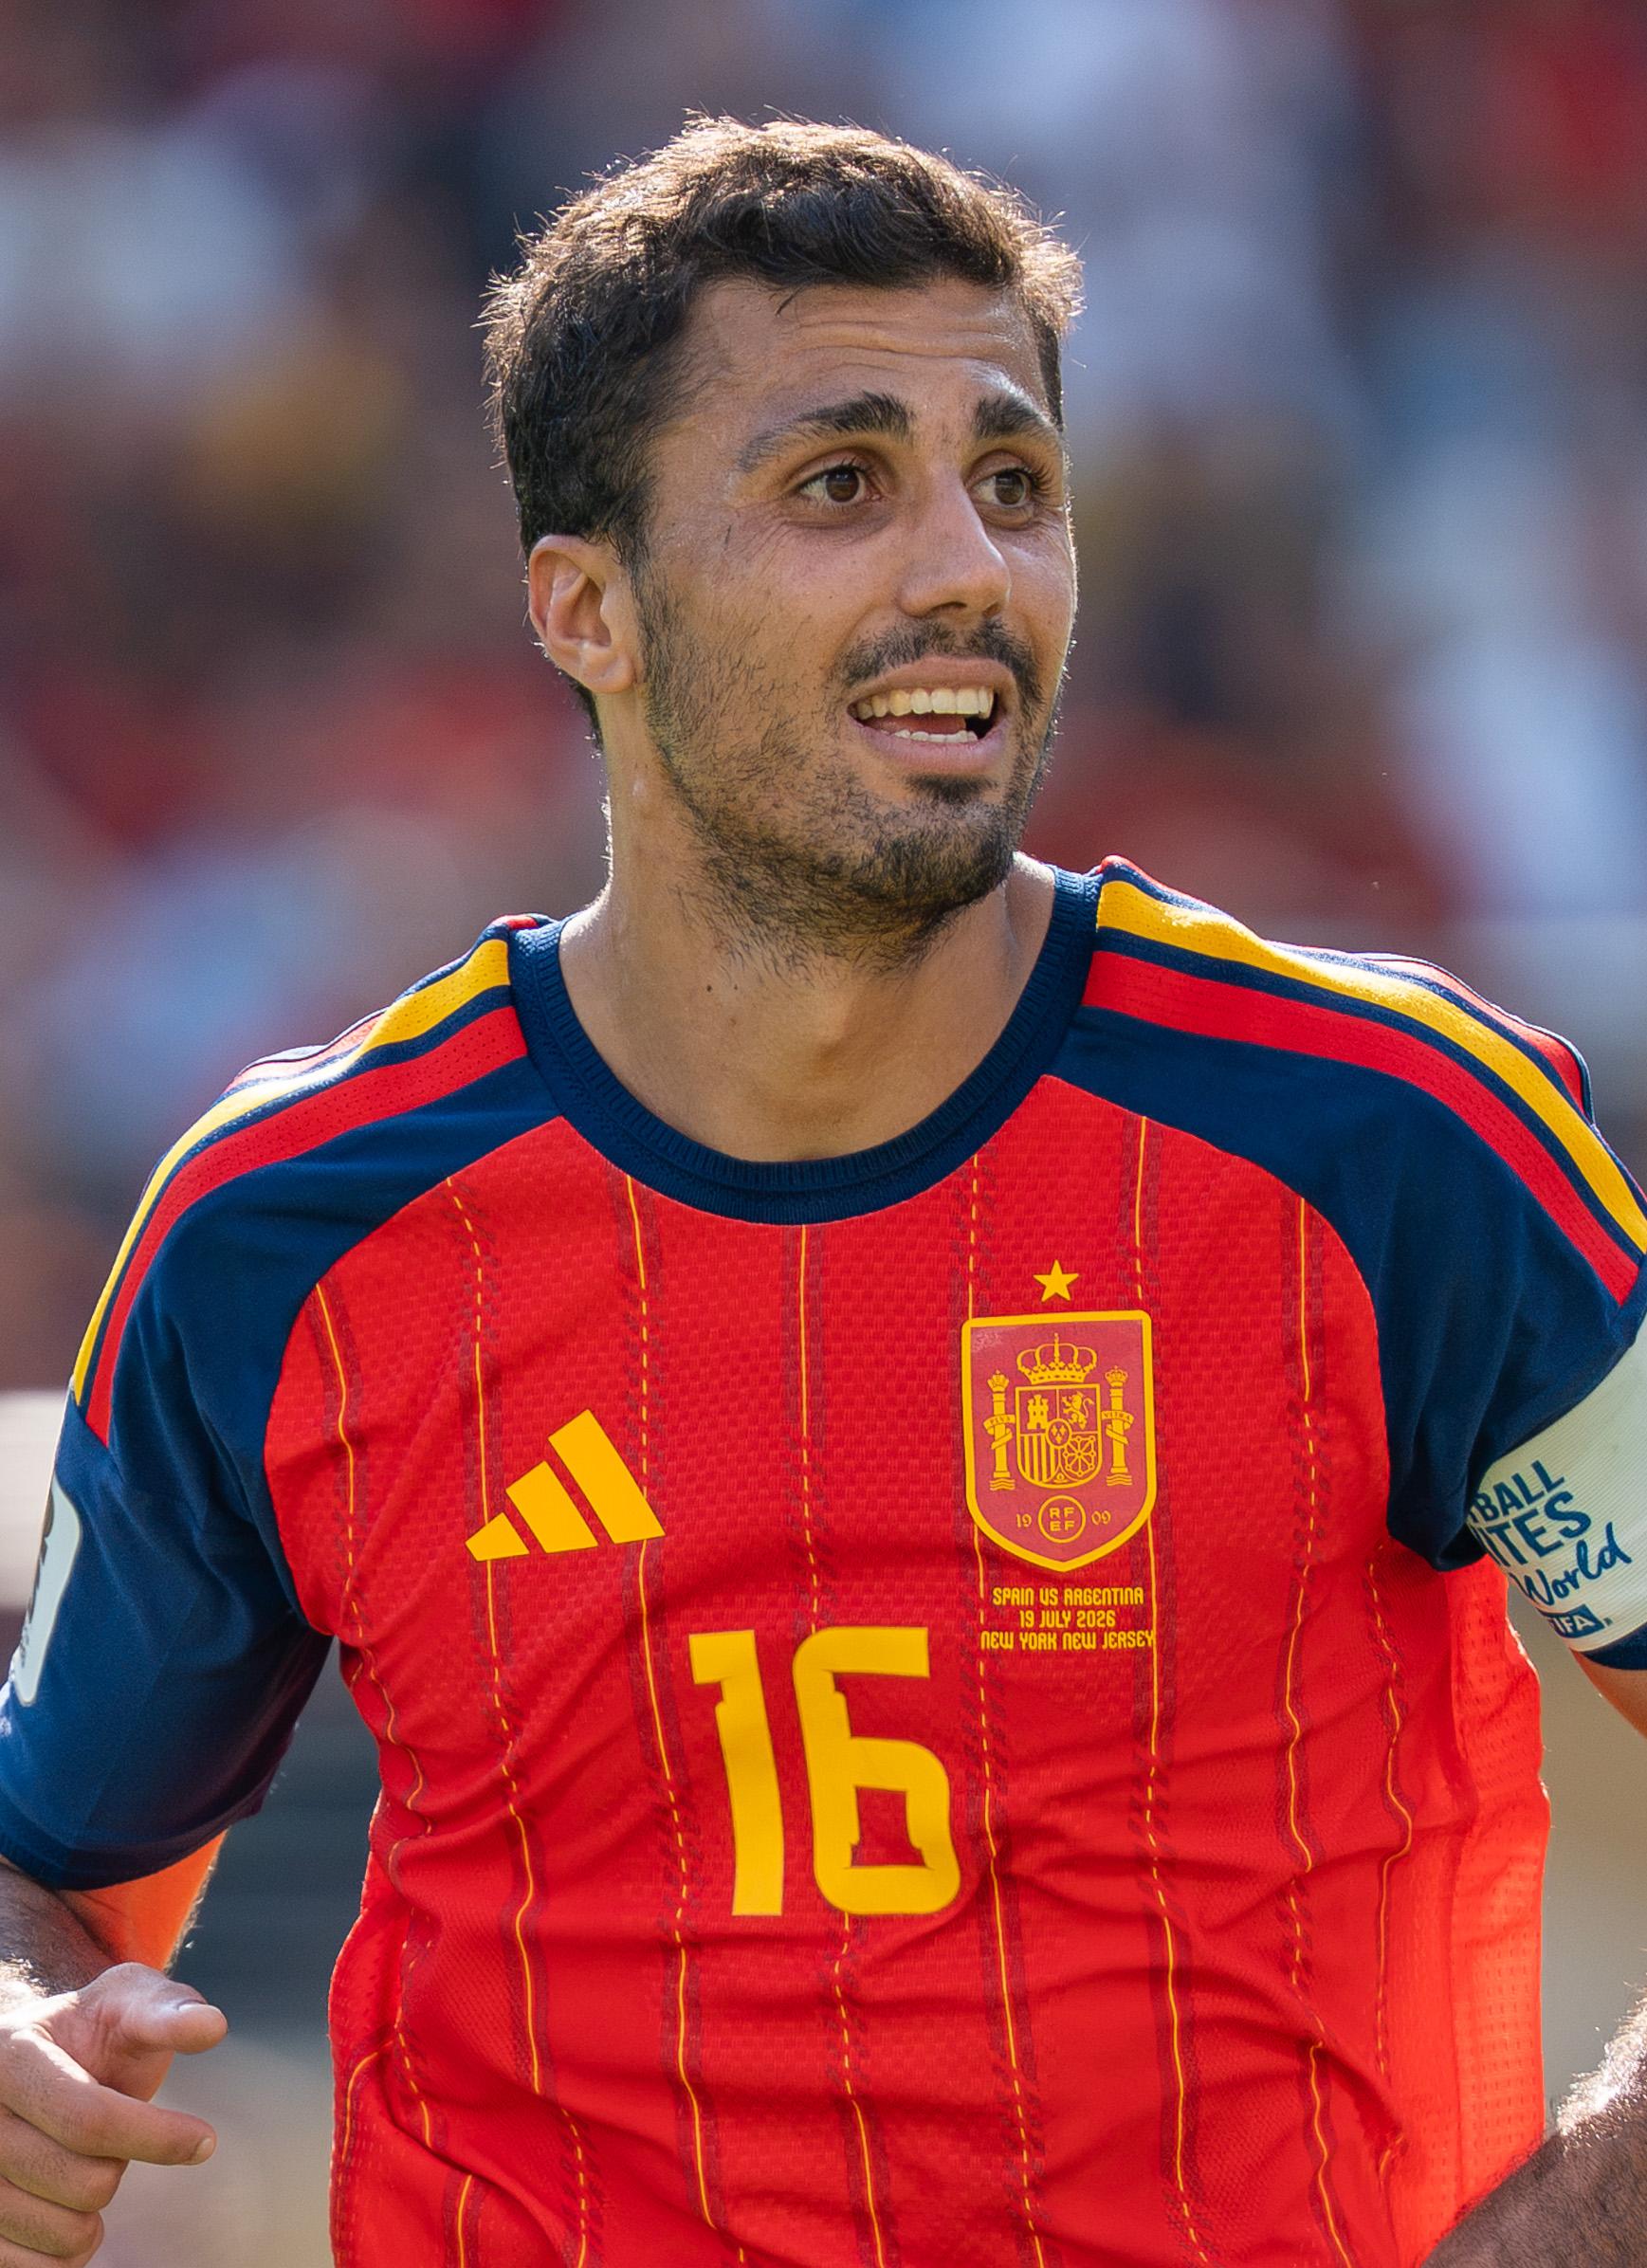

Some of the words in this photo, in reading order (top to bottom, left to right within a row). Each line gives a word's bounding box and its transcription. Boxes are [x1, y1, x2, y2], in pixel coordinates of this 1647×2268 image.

[1016, 1513, 1032, 1527] 19
[1091, 1510, 1111, 1525] 09
[1509, 1521, 1632, 1606] World
[993, 1587, 1034, 1606] SPAIN
[1064, 1587, 1144, 1606] ARGENTINA
[1019, 1610, 1034, 1628] 19
[1039, 1610, 1071, 1628] JULY
[1076, 1610, 1116, 1628] 2026
[980, 1631, 1015, 1651] NEW
[1019, 1632, 1057, 1650] YORK
[1062, 1631, 1096, 1650] NEW
[1102, 1629, 1154, 1649] JERSEY
[688, 1626, 961, 1916] 16
